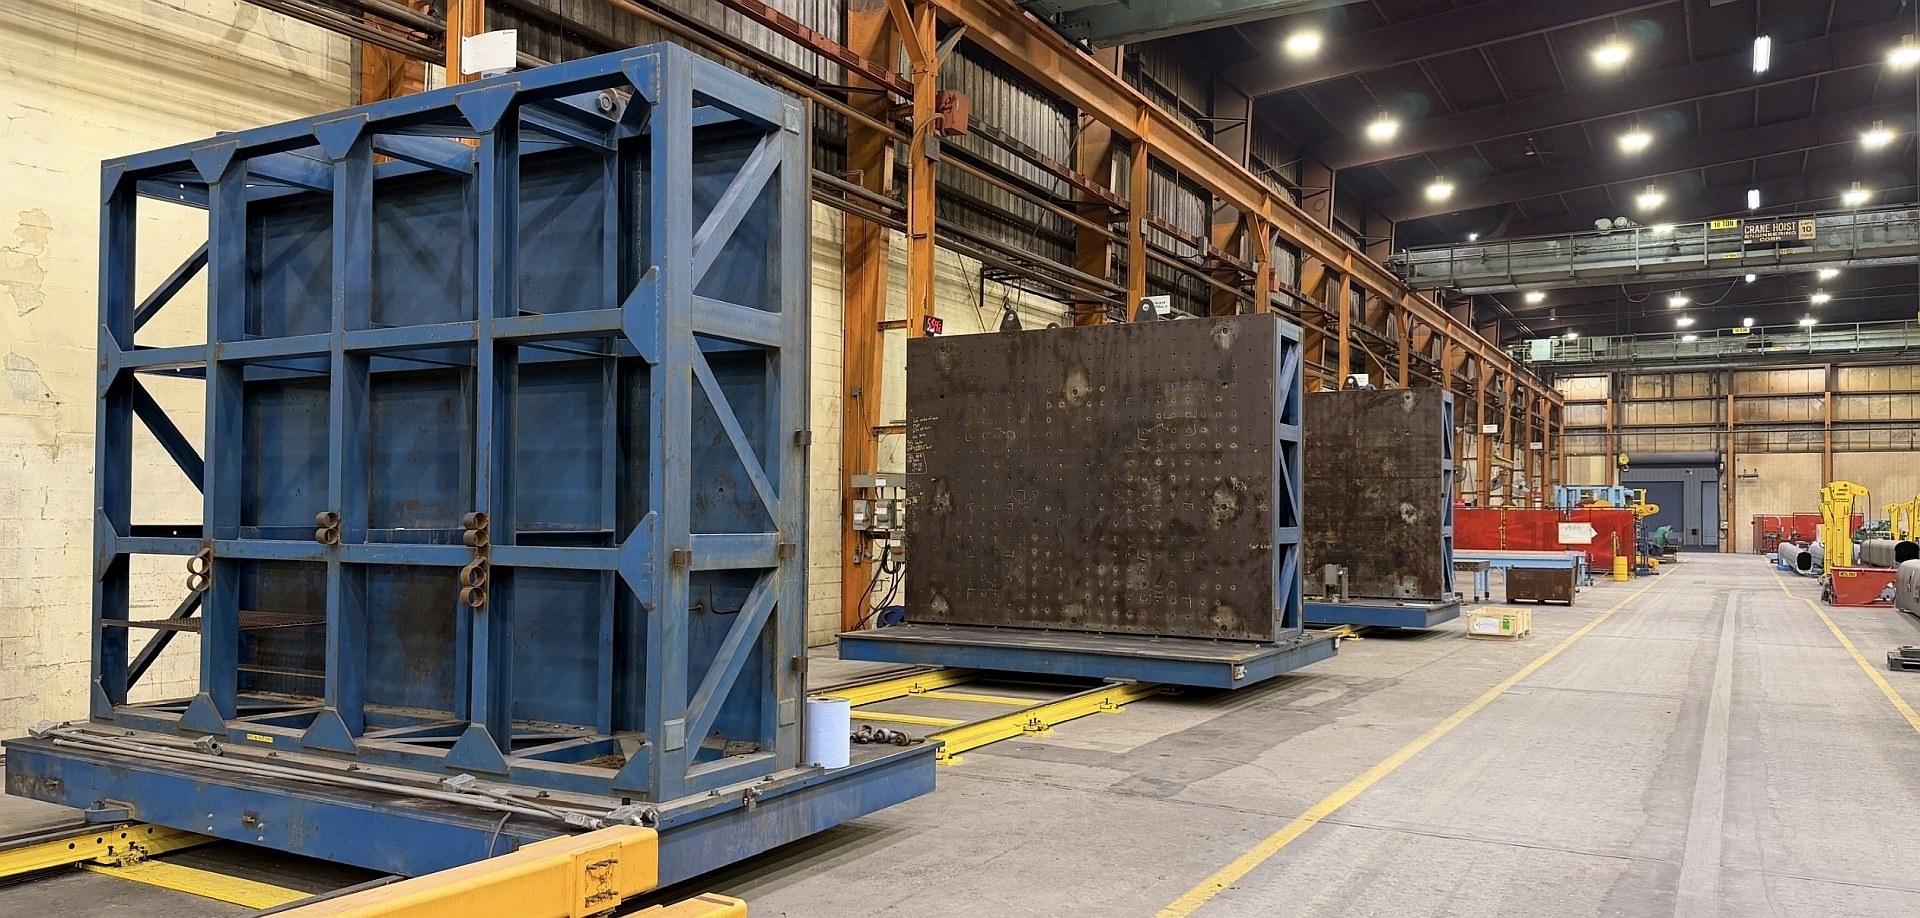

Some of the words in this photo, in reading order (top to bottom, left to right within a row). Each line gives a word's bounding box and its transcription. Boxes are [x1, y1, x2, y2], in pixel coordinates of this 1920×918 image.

[1744, 223, 1771, 235] CRANE
[1772, 221, 1797, 232] HOIST
[1802, 225, 1812, 233] 10
[1744, 230, 1797, 239] ENGINEERING
